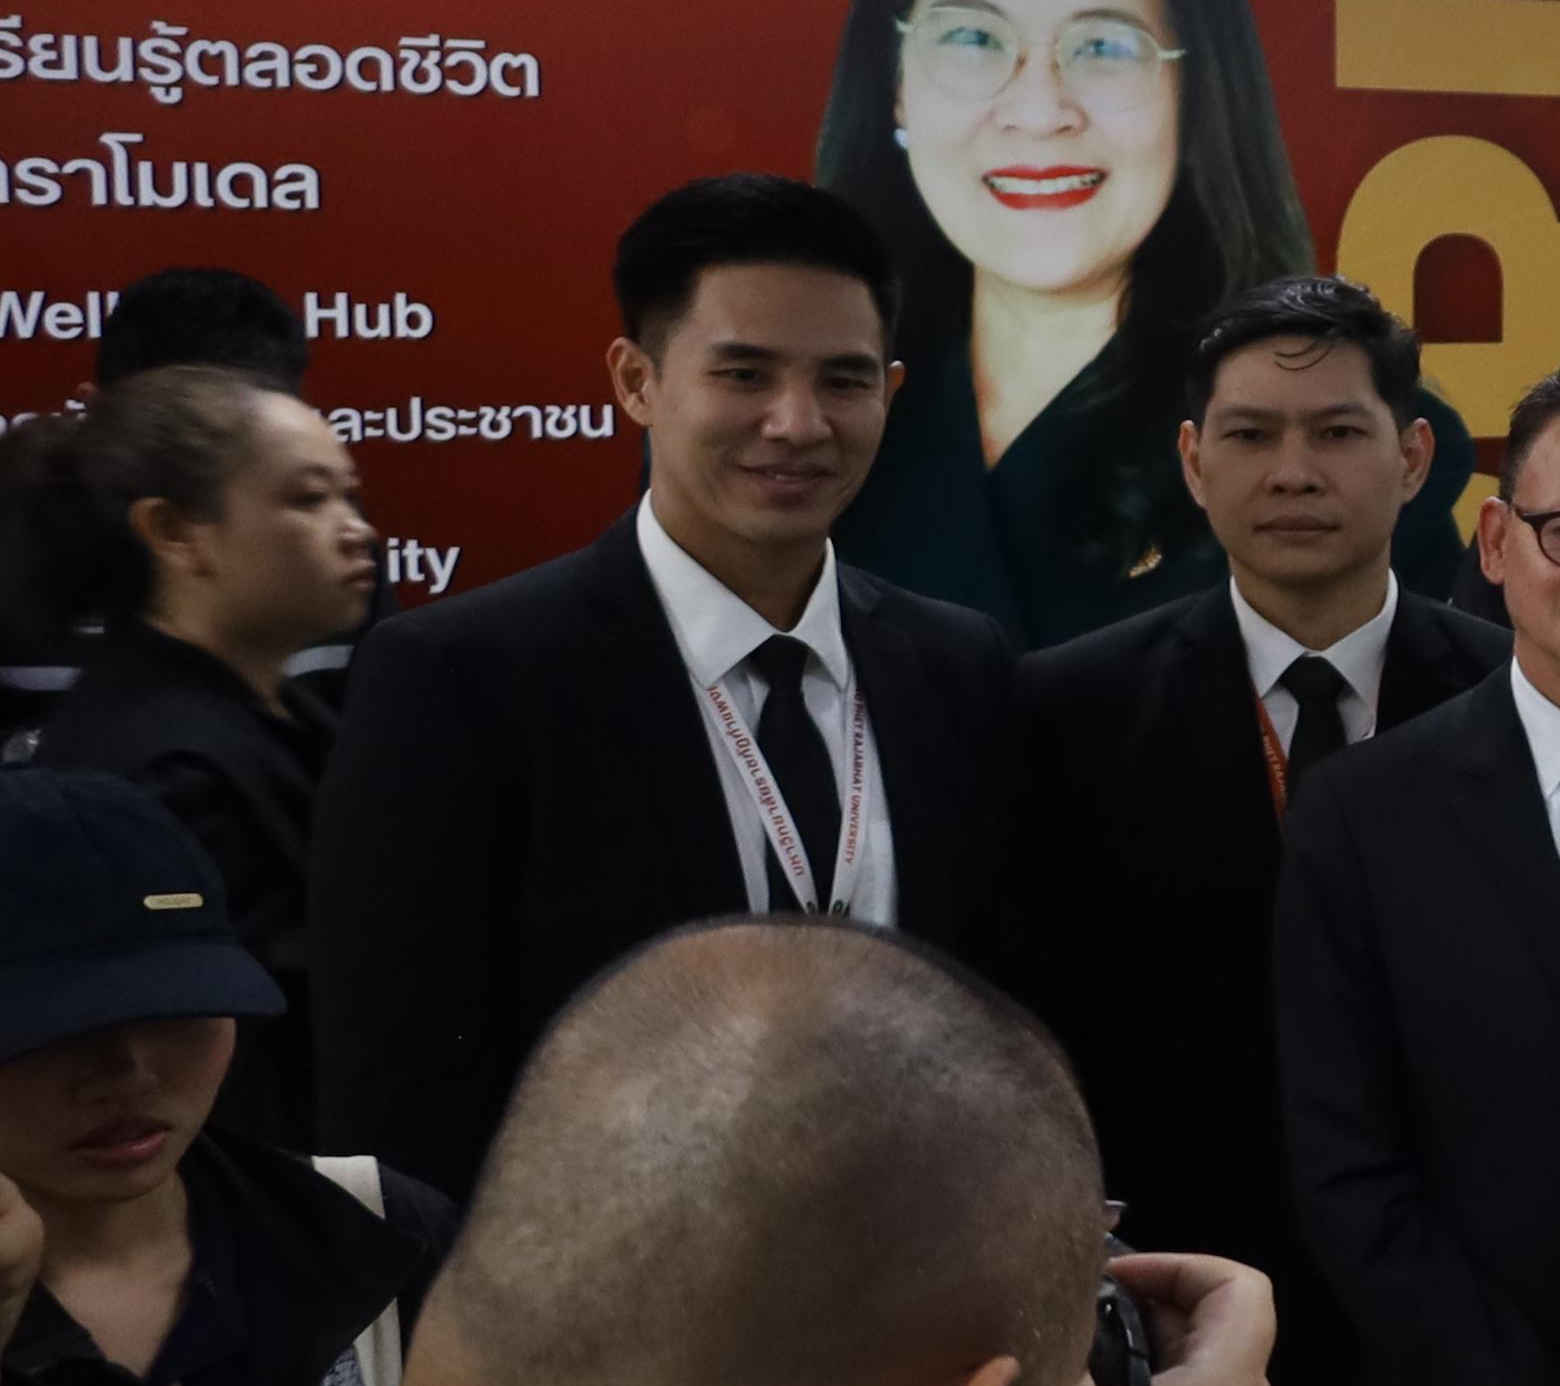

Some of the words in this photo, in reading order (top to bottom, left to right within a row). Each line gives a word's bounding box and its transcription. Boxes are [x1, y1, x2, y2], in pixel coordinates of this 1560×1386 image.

[0, 133, 320, 210] ราโมเดล
[304, 291, 434, 340] Hub
[308, 397, 615, 444] ละประชาชน
